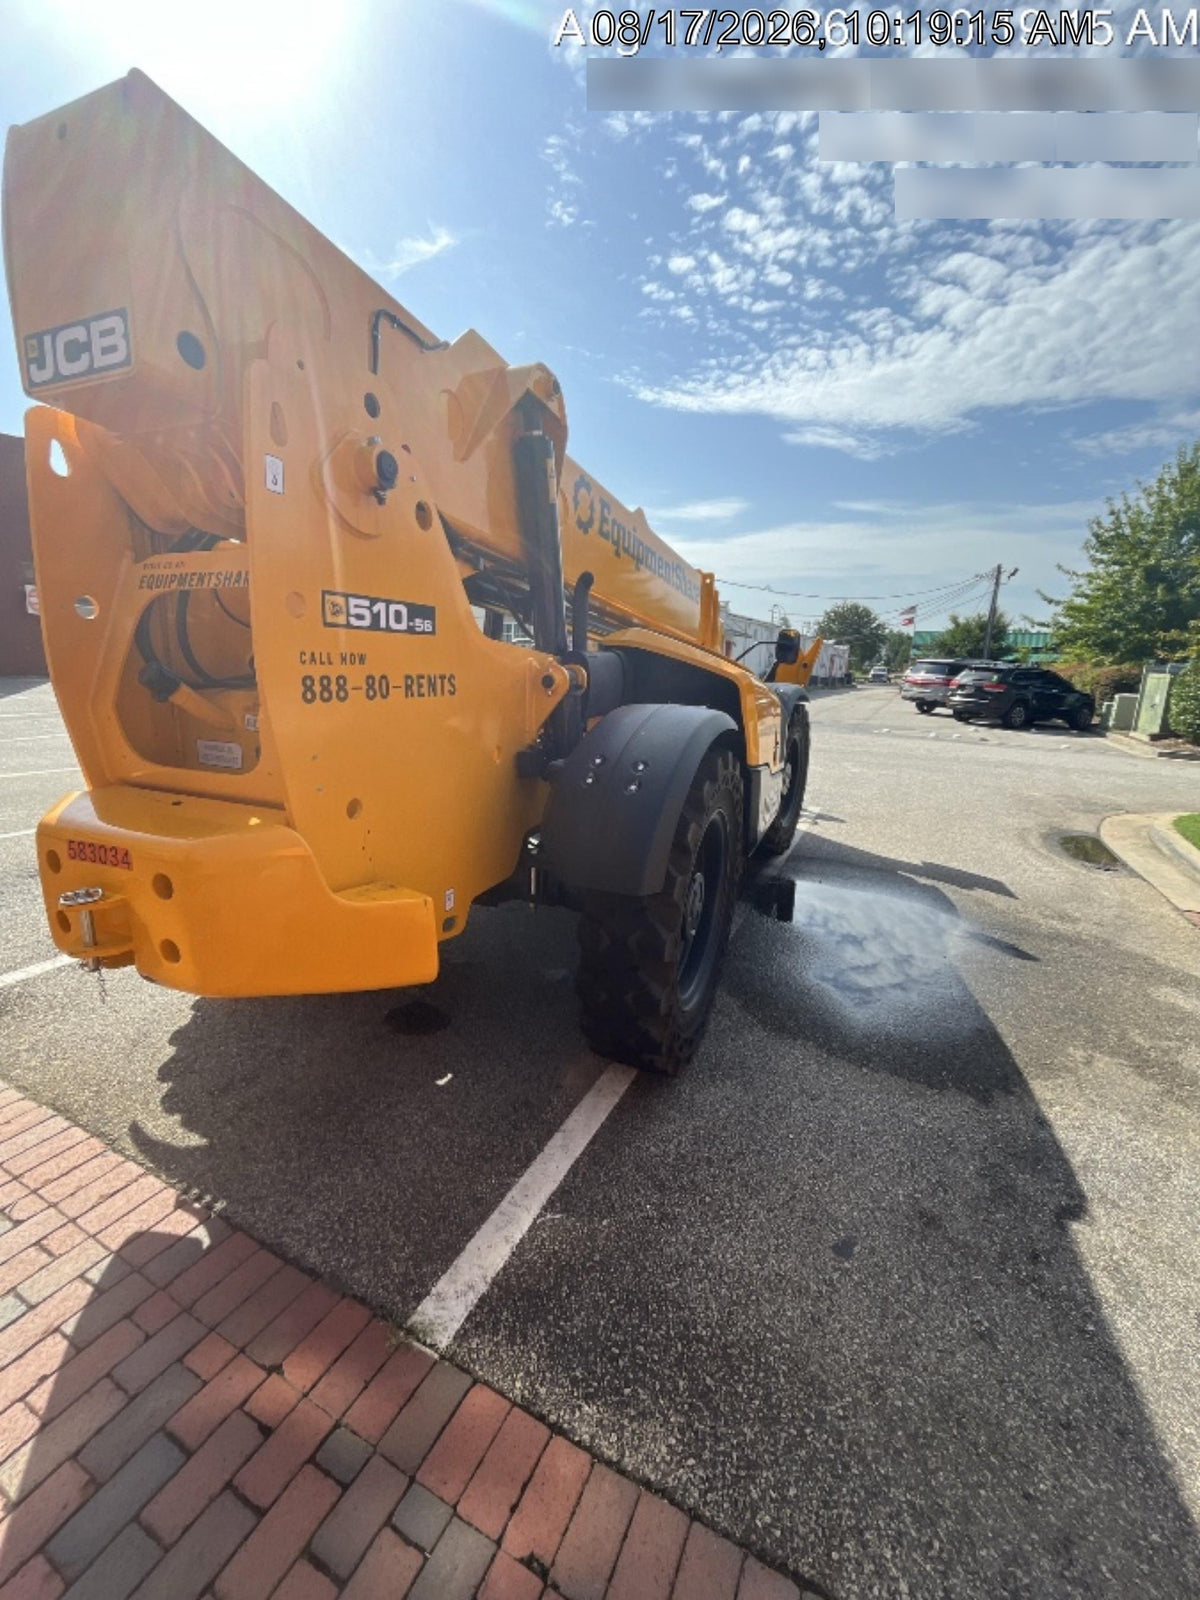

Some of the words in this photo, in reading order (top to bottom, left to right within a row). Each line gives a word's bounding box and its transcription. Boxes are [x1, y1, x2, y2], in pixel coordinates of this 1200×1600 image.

[29, 315, 128, 383] JCB
[300, 652, 333, 665] CALL
[340, 652, 366, 665] NOW
[301, 673, 456, 704] 888-80-RENTS
[68, 840, 133, 871] 583034
